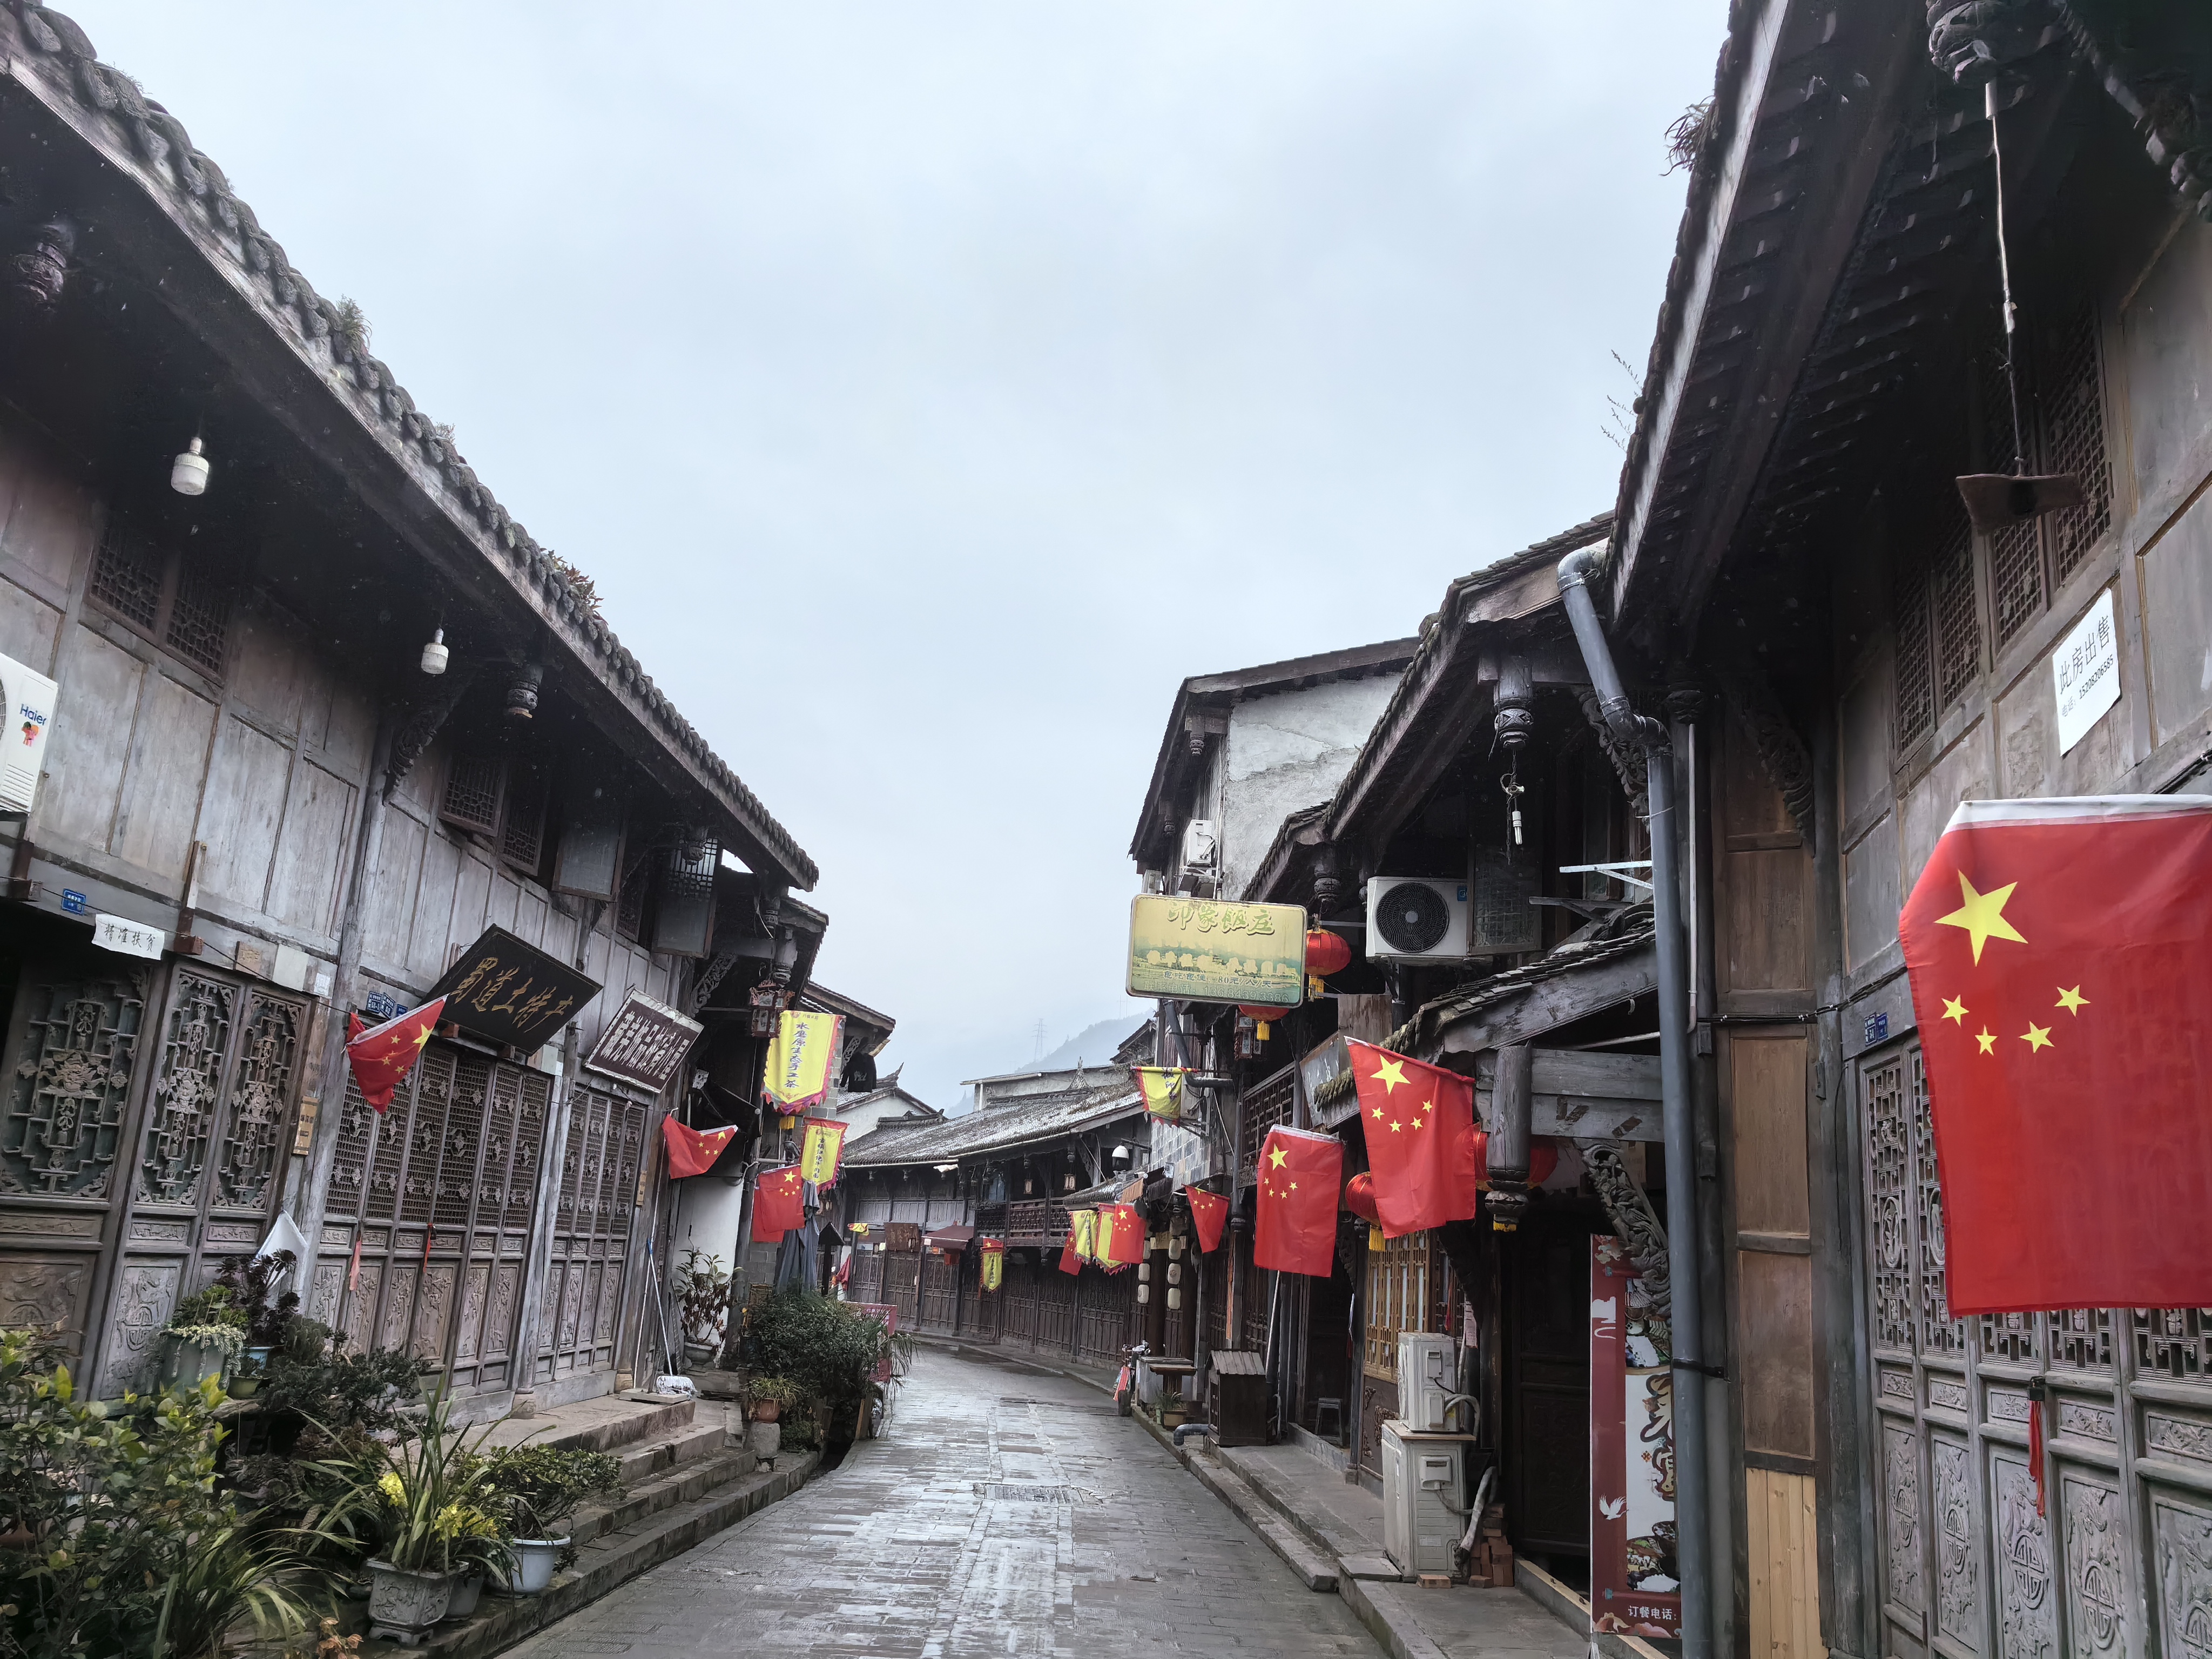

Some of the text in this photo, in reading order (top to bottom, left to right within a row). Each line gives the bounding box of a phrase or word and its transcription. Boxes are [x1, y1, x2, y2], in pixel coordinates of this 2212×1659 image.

[2060, 615, 2110, 695] 此房出售
[19, 703, 47, 726] Haier
[104, 922, 156, 953] 精准扶贫
[1168, 901, 1274, 935] 印象饭庄
[450, 957, 574, 1033] 蜀道土特产
[784, 1022, 810, 1088] 水磨原生态手工茶
